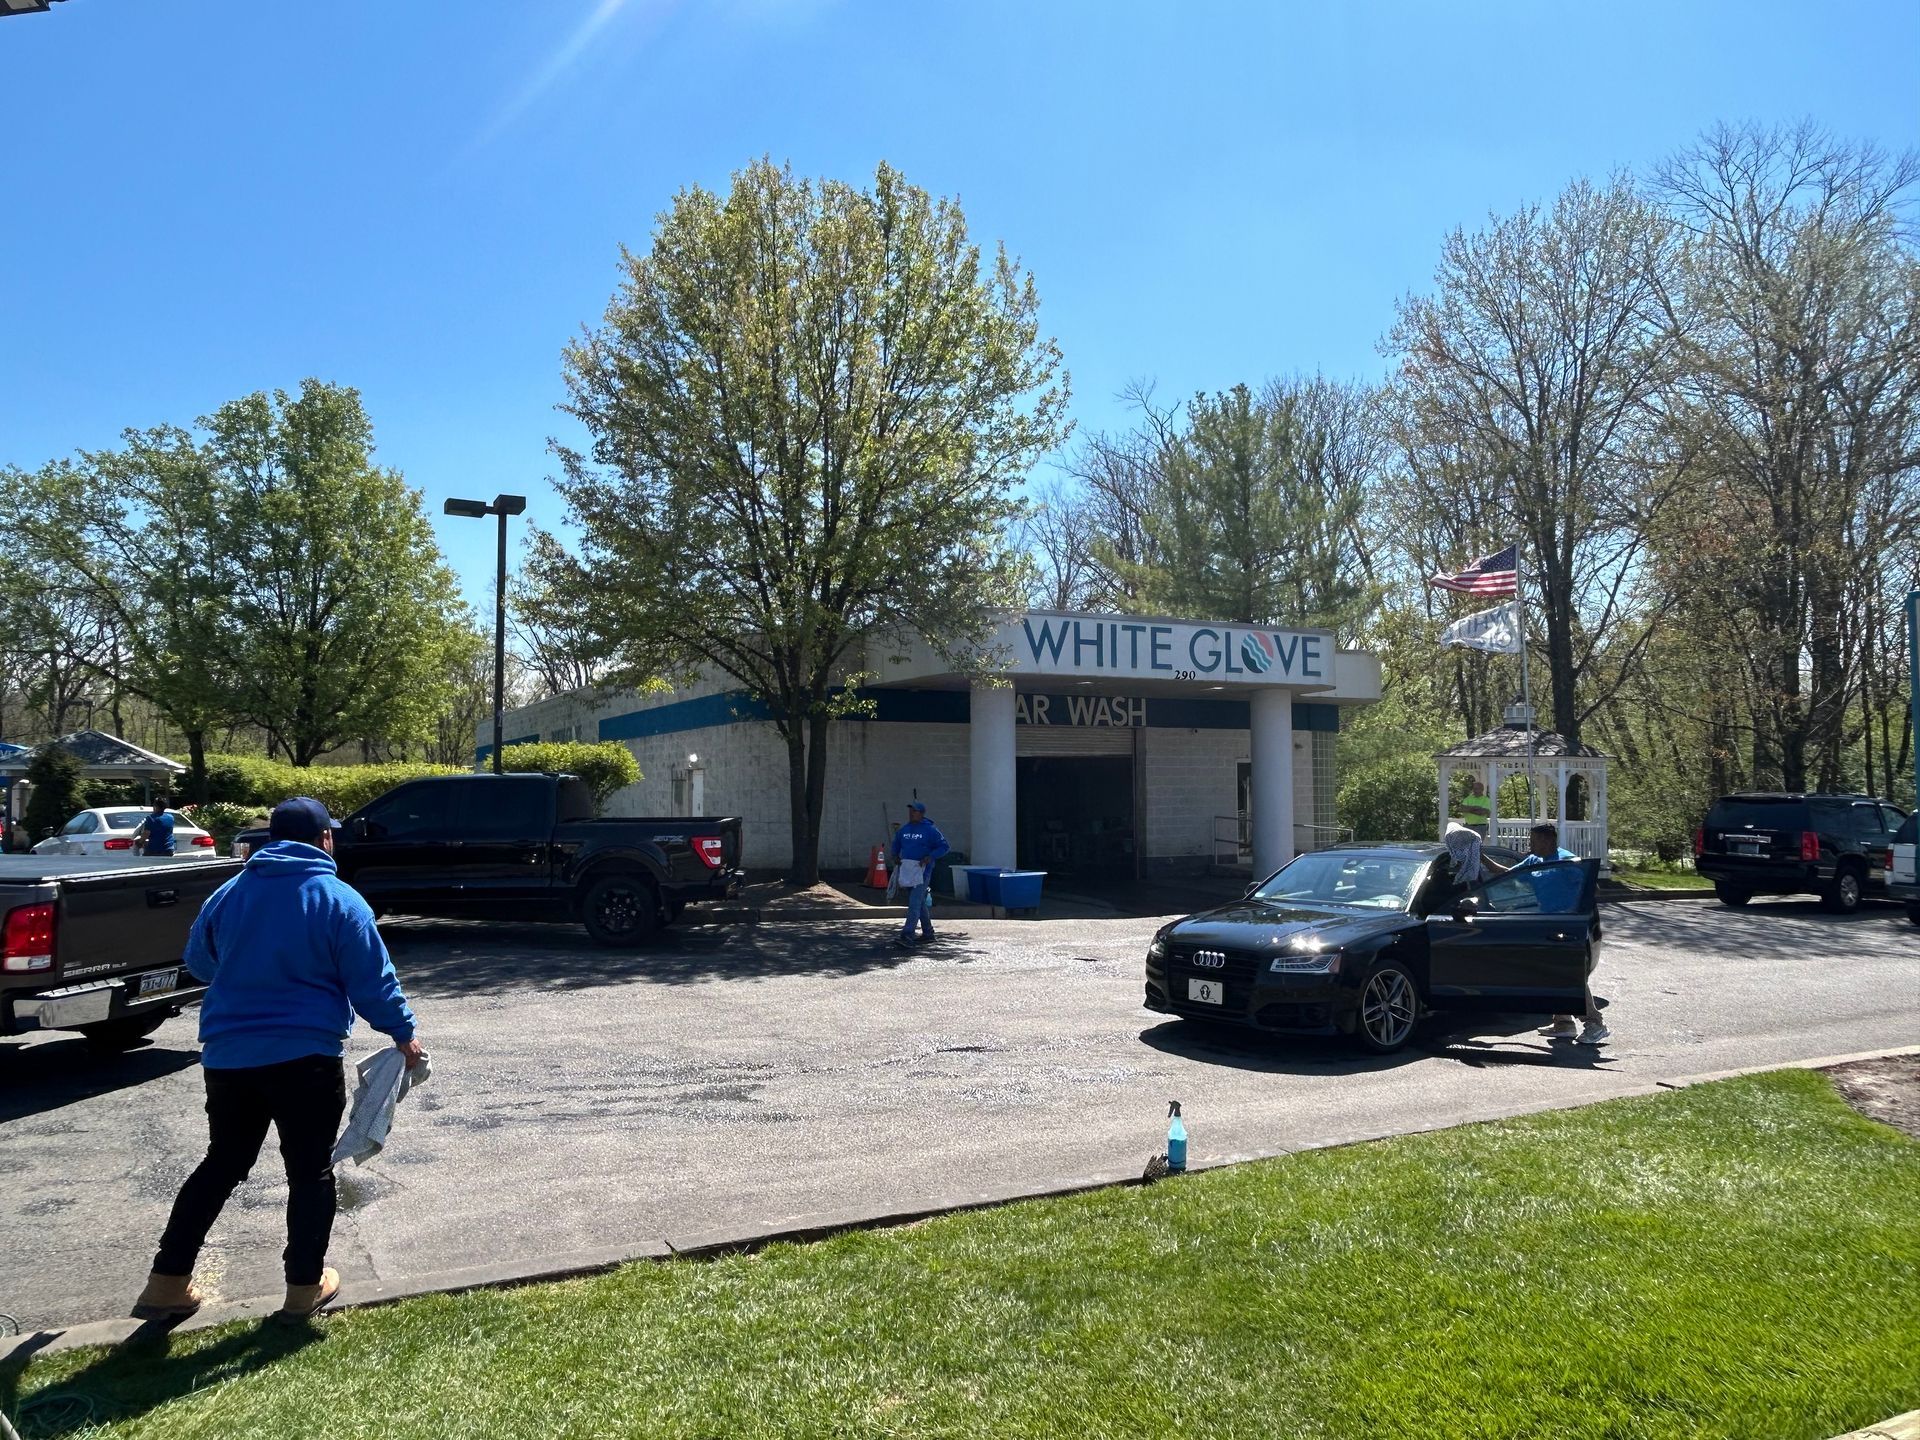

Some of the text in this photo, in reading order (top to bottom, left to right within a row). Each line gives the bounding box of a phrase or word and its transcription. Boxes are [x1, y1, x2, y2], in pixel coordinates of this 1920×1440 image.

[1023, 617, 1322, 677] WHITE GLOVE
[1174, 669, 1196, 681] 290
[1016, 694, 1147, 727] AR WASH
[63, 963, 111, 978] SIERRA
